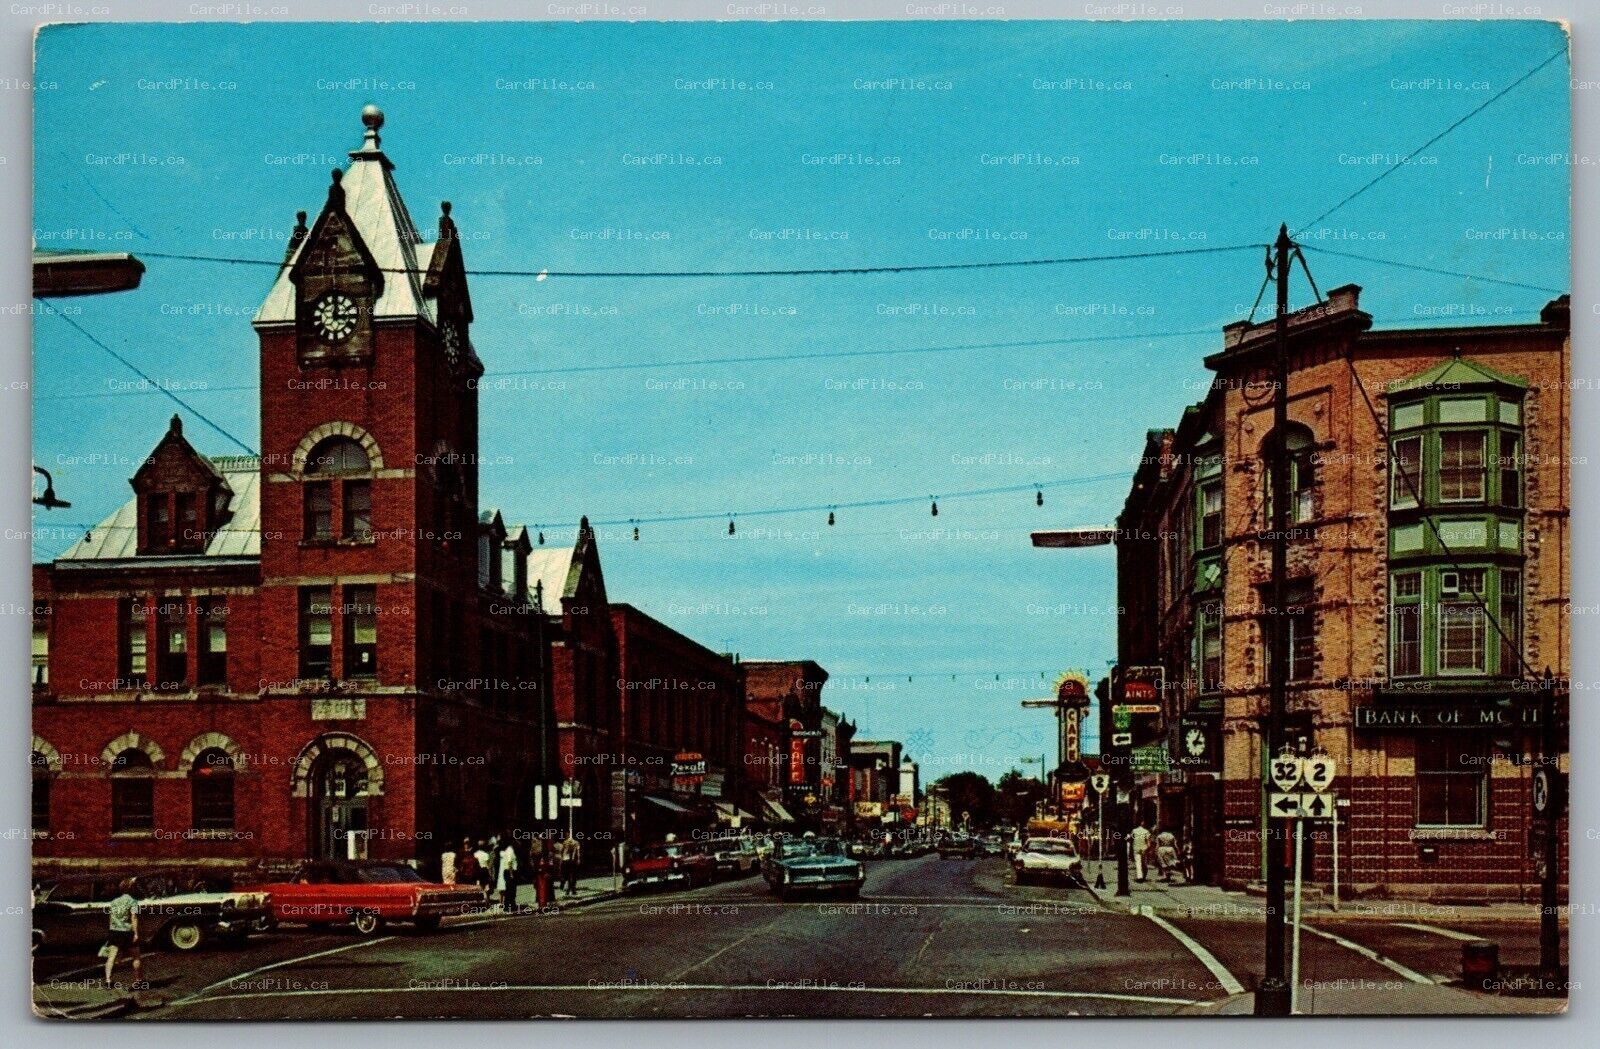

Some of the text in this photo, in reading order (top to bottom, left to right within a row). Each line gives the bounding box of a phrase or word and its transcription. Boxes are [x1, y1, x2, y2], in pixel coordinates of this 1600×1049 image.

[1365, 710, 1421, 724] BANK
[1066, 708, 1077, 763] CAFE
[1275, 762, 1297, 781] 32
[1313, 763, 1326, 781] 2
[1096, 776, 1105, 788] 2
